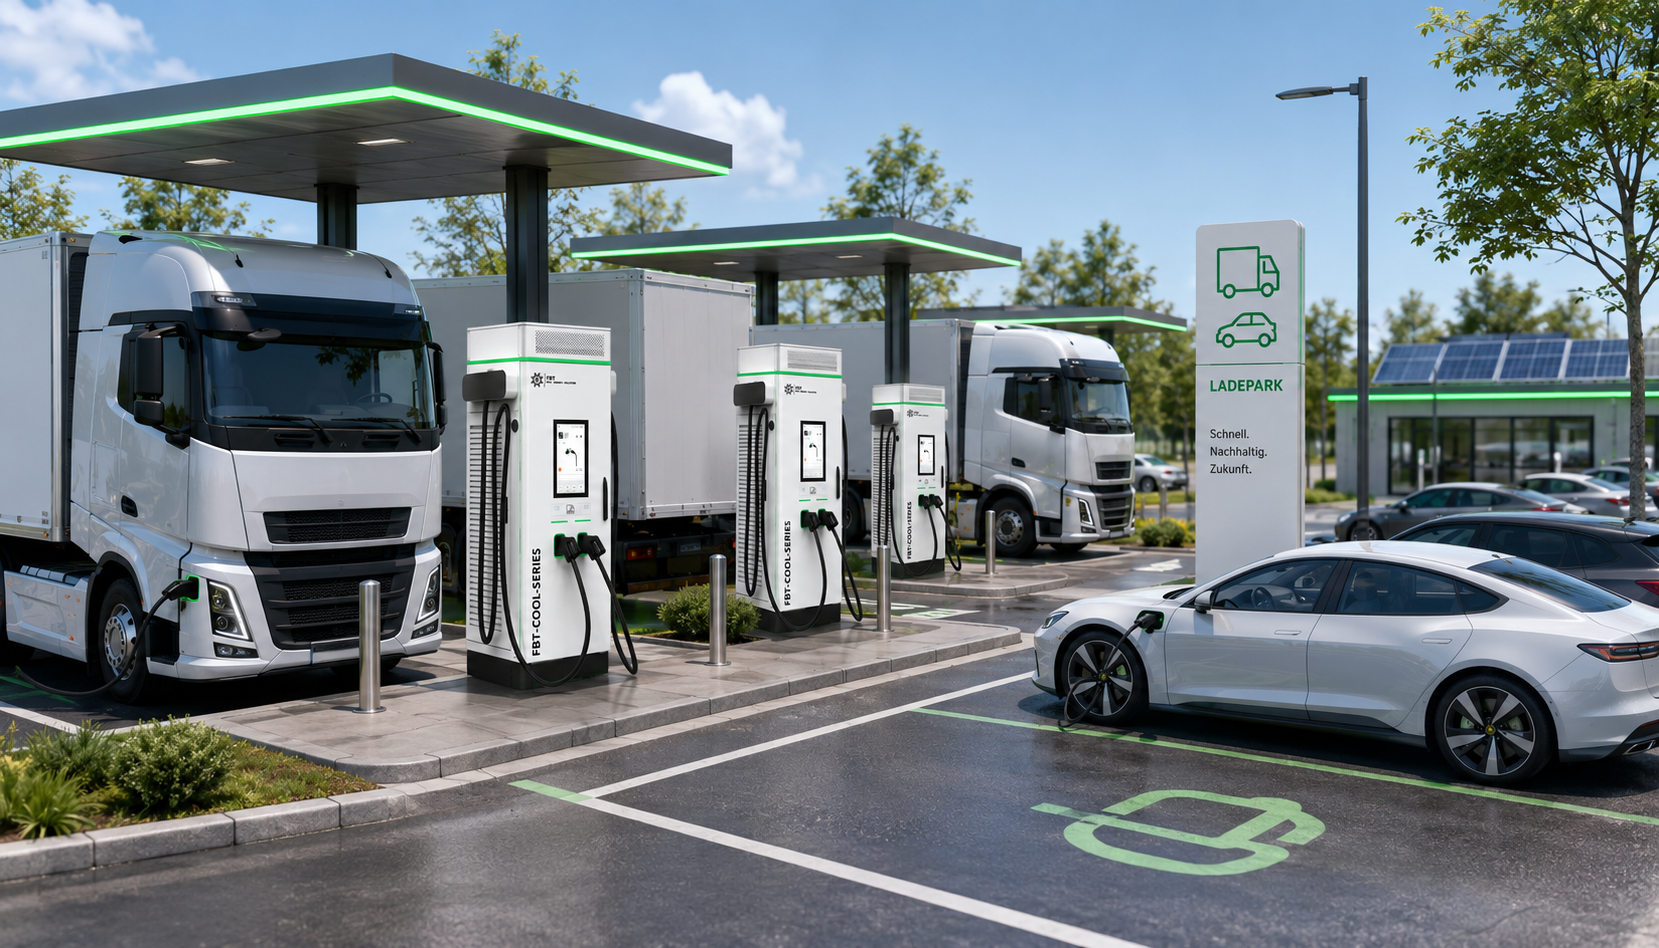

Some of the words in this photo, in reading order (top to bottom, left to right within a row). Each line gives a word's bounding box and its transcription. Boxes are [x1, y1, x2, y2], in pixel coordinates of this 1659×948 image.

[1209, 379, 1283, 392] LADEPARK
[1209, 429, 1250, 439] Schnell.
[1209, 446, 1268, 459] Nachhaltig.
[1209, 463, 1252, 474] Zukunft.
[532, 548, 541, 657] FBT-COOL-SERIES
